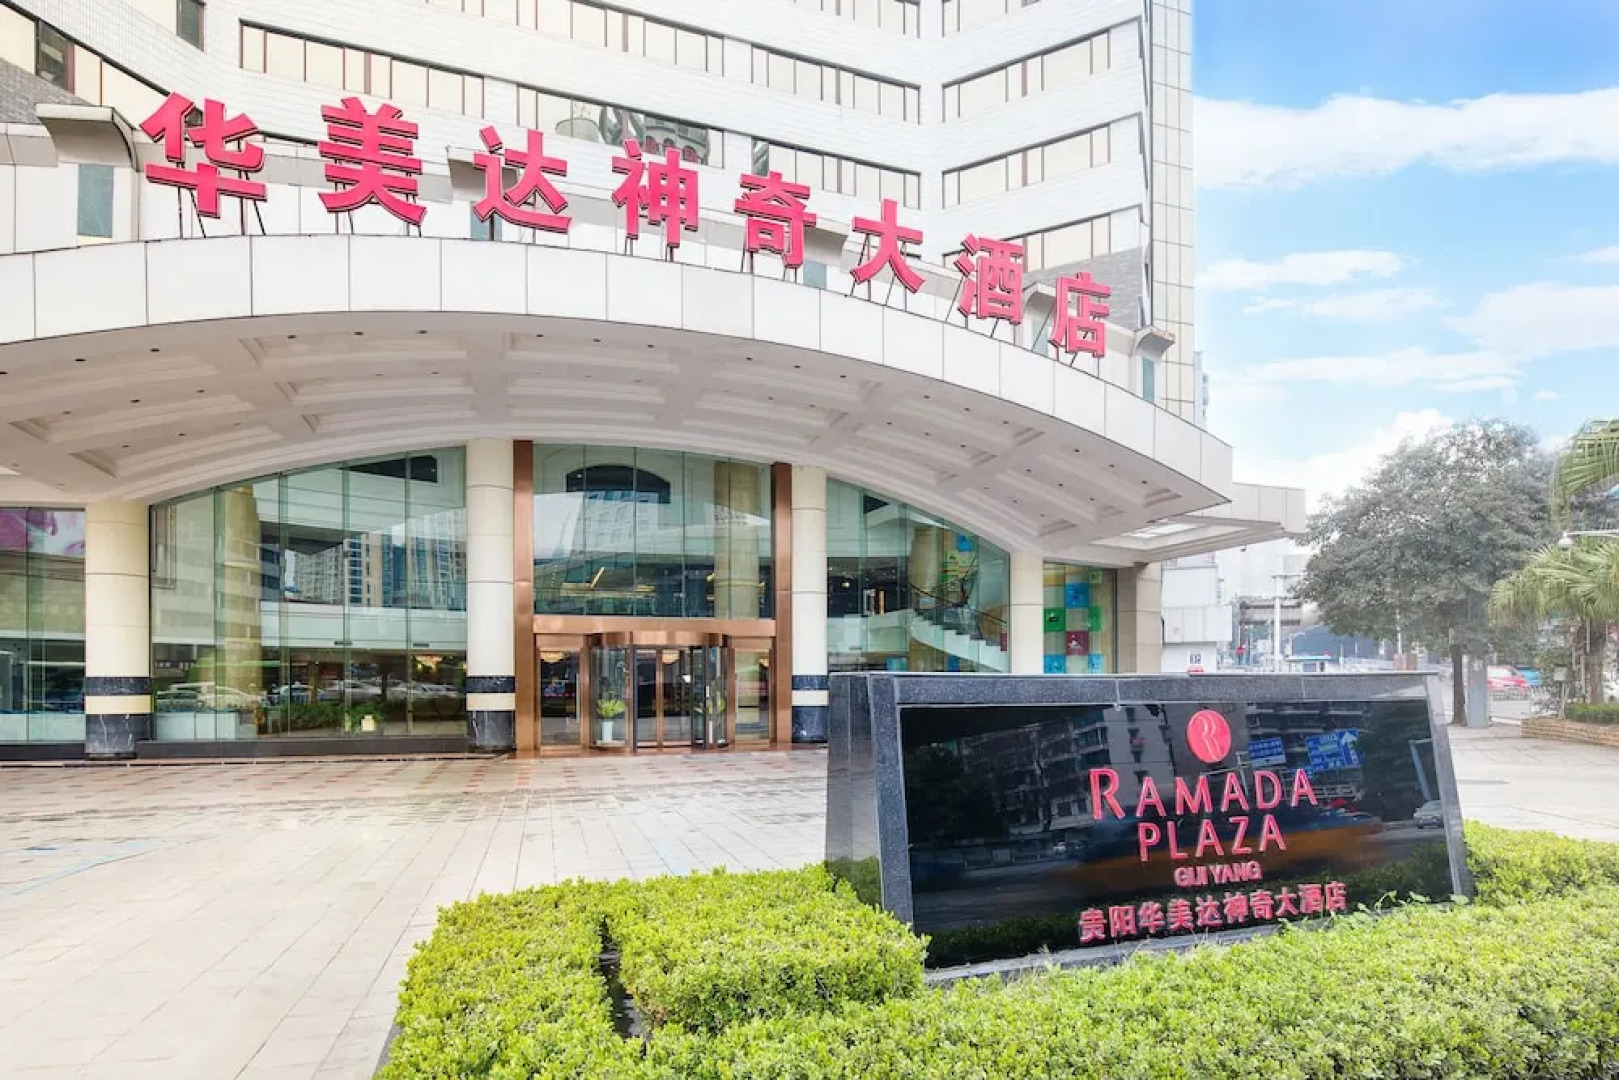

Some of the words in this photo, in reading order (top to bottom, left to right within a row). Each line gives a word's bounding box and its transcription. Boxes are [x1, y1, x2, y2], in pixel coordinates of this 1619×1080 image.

[139, 92, 1111, 359] 华美达神奇大酒店
[1088, 768, 1319, 820] RAMADA
[1136, 814, 1288, 862] PLAZA
[1174, 861, 1263, 888] GUIYANG
[1079, 881, 1349, 944] 贵阳华美达神奇大酒店
